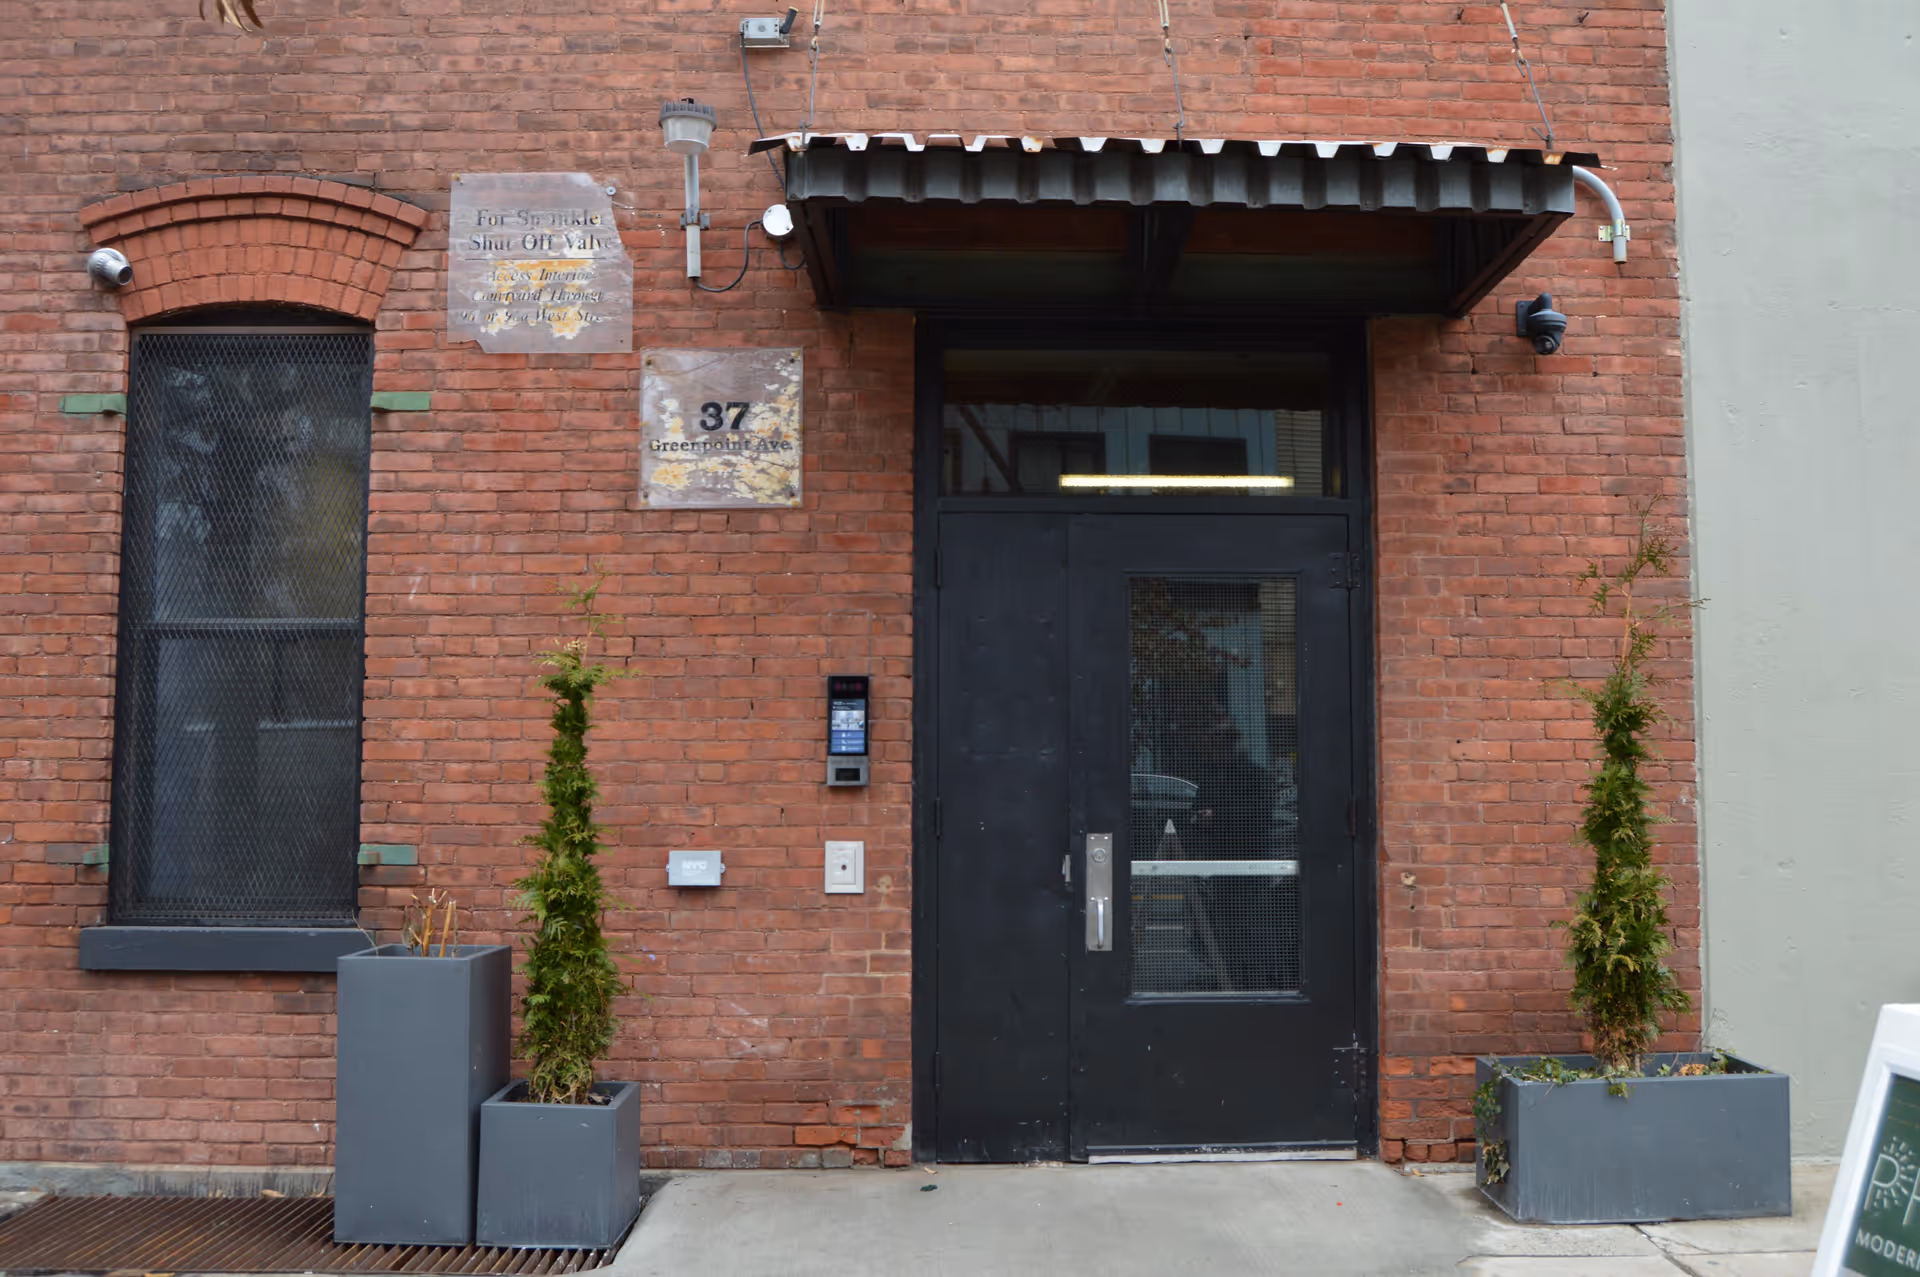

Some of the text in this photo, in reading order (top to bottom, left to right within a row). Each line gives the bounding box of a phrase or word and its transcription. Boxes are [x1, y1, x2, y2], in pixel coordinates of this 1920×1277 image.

[476, 209, 505, 226] For
[468, 233, 511, 251] Shut
[521, 232, 556, 251] Off
[538, 268, 594, 282] Interior
[699, 401, 750, 431] 37
[650, 438, 751, 455] Greenpoint
